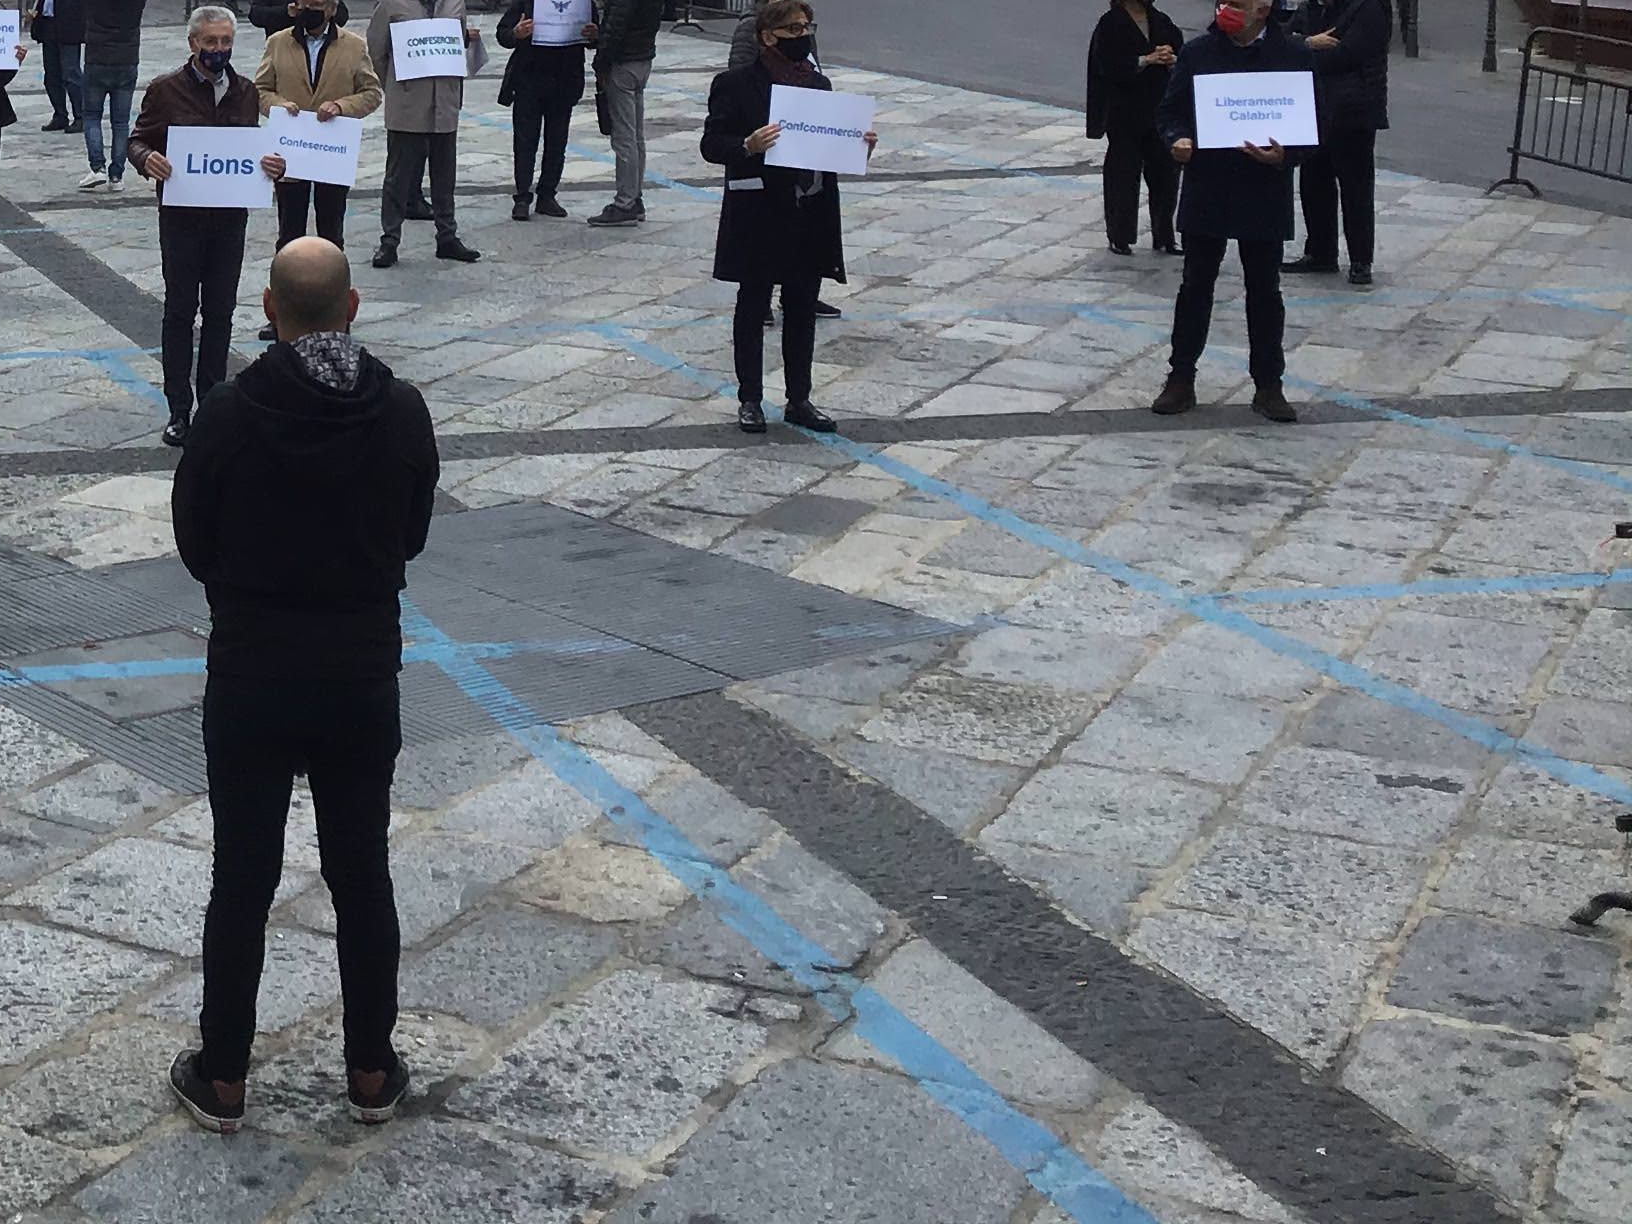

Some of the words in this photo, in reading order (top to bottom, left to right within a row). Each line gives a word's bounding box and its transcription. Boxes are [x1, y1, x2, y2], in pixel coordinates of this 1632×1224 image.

[1215, 96, 1295, 107] Liberamente
[1229, 110, 1283, 121] Calabria
[779, 119, 863, 138] Confcommercio
[279, 135, 347, 154] Confesercenti
[186, 153, 254, 175] Lions
